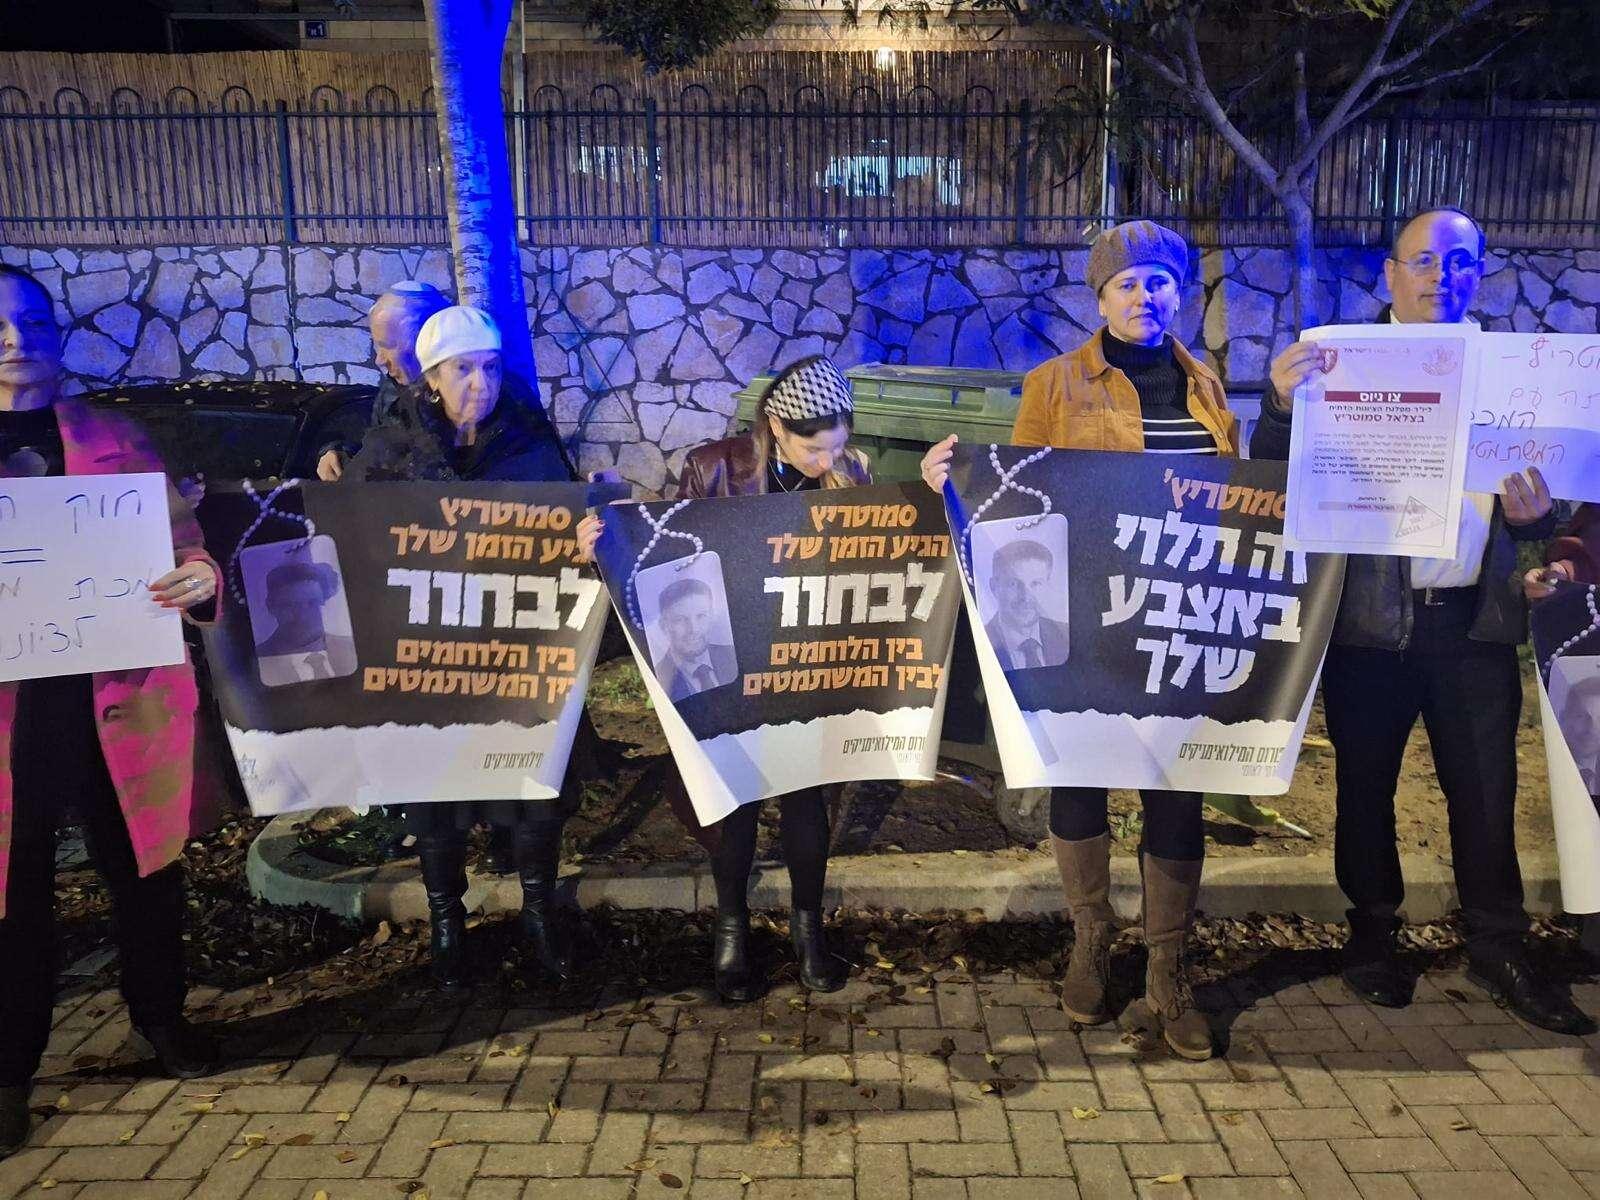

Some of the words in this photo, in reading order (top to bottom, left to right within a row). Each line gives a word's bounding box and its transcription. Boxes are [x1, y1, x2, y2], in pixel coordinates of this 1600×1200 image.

[1359, 392, 1384, 402] גיוס
[1388, 393, 1402, 402] צו
[1386, 413, 1425, 423] בצלאל
[1471, 440, 1565, 465] המשתמטי
[65, 489, 142, 533] חוק
[439, 496, 572, 531] סמוטריץ
[811, 503, 917, 533] סמוטריץ
[390, 523, 458, 556] שלך
[465, 531, 535, 562] הזמן
[767, 532, 823, 564] שלך
[829, 535, 887, 562] הזמן
[890, 534, 950, 561] הגיע
[1113, 510, 1242, 576] תלוי
[387, 567, 602, 632] לבחור
[763, 562, 945, 628] לבחור
[1101, 574, 1302, 643] באצבע
[396, 639, 529, 668] הלוחמים
[536, 645, 577, 673] בין
[770, 635, 880, 666] הלוחמים
[886, 637, 923, 663] בין
[1136, 633, 1256, 694] שלך
[363, 667, 539, 699] המשתמטים
[743, 665, 889, 697] המשתמטים
[908, 736, 927, 753] ורום
